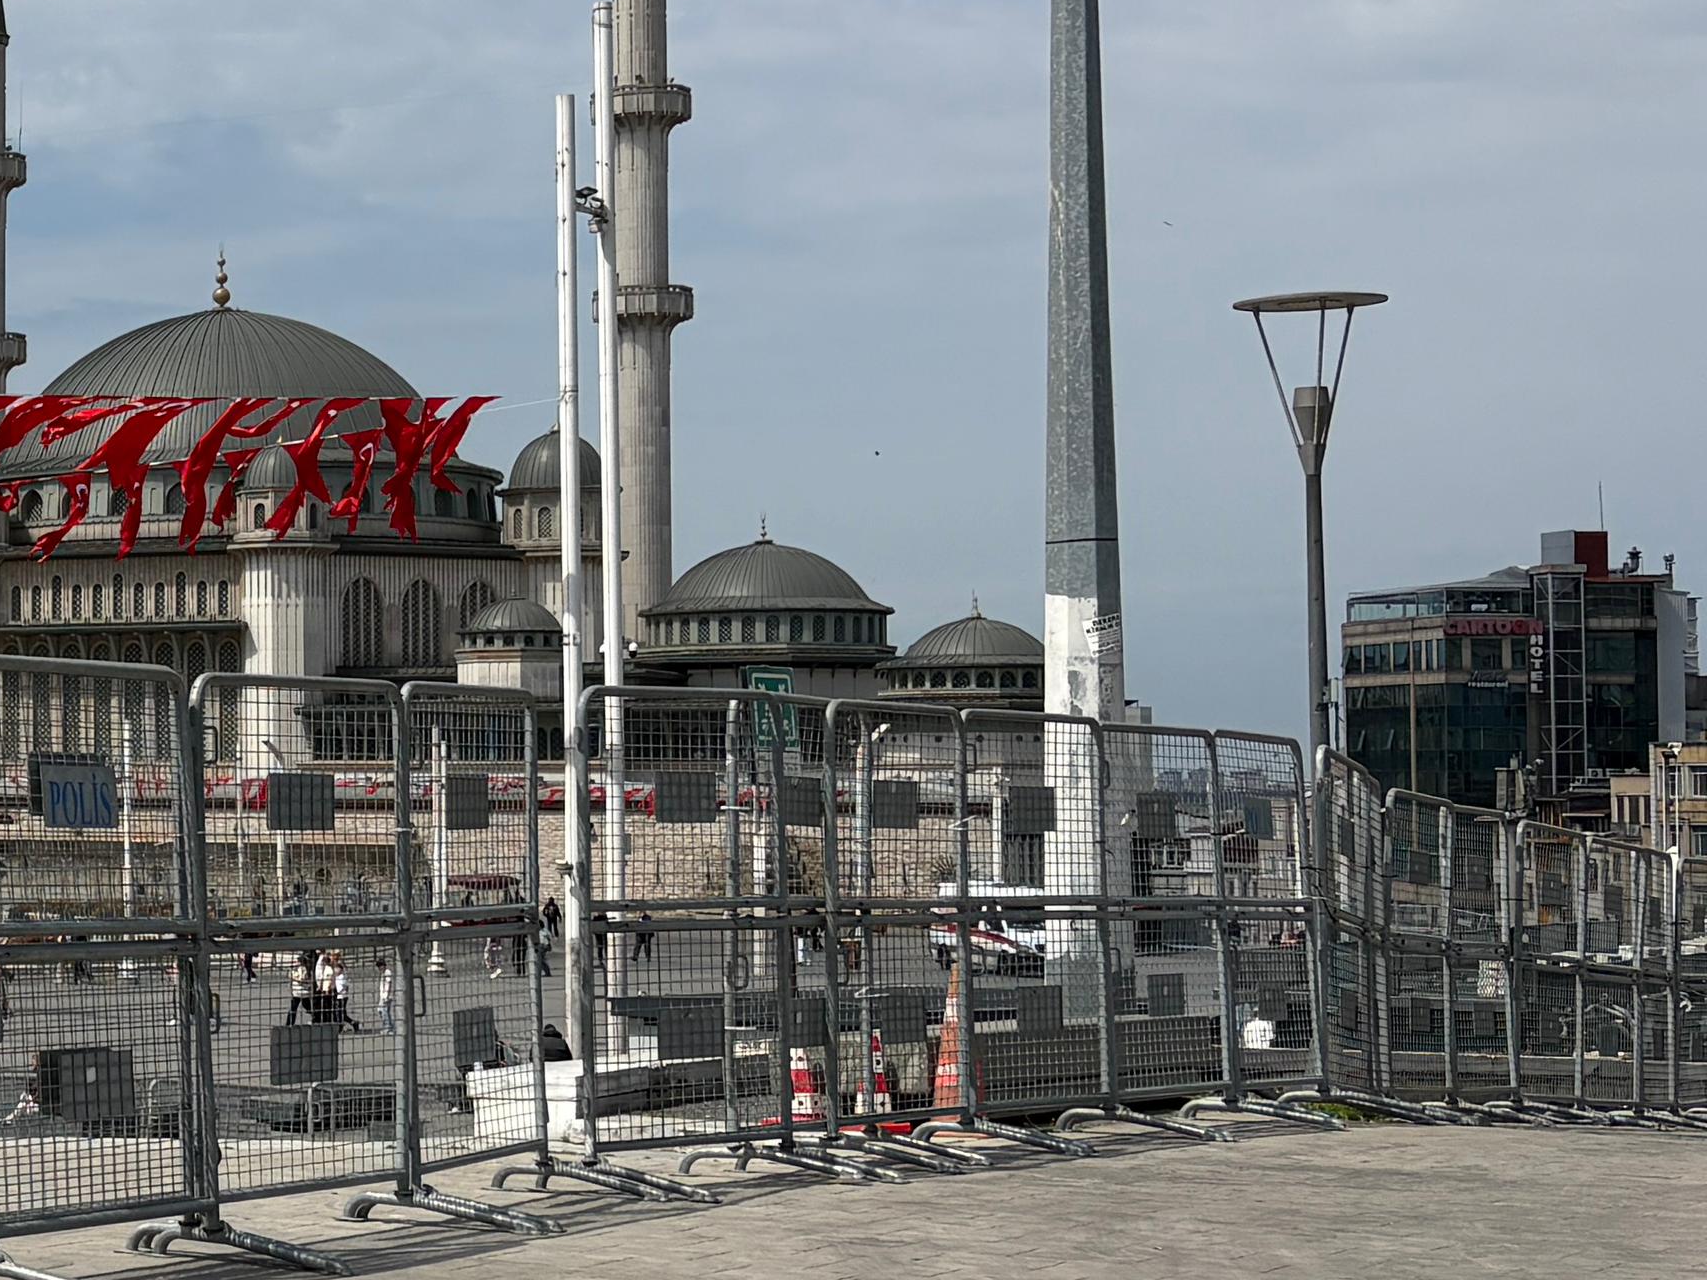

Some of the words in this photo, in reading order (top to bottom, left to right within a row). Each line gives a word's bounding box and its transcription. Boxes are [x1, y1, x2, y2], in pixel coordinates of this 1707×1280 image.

[1443, 619, 1544, 636] CARTOON
[1530, 634, 1544, 694] HOTEL
[1468, 680, 1509, 688] restaurant
[48, 773, 112, 826] POLİS
